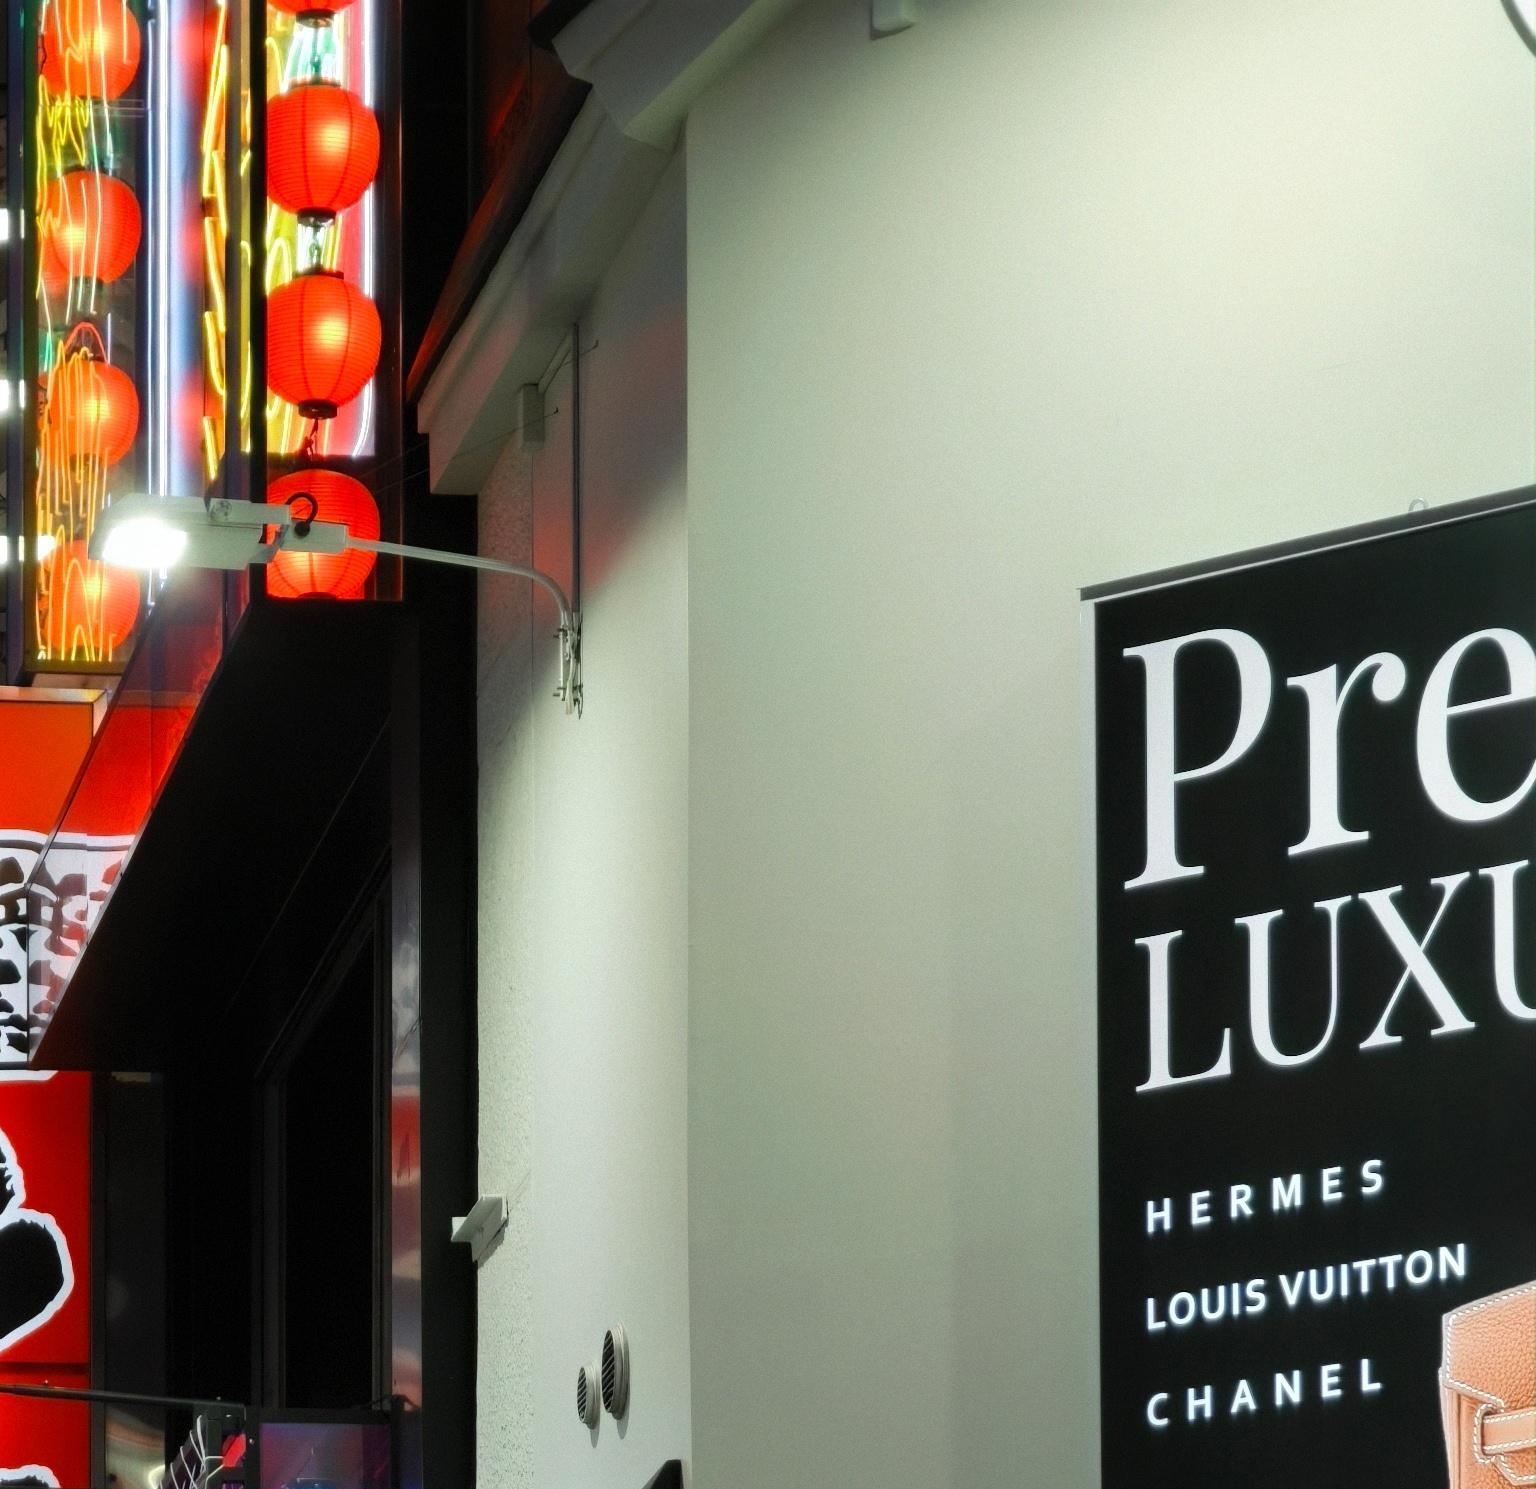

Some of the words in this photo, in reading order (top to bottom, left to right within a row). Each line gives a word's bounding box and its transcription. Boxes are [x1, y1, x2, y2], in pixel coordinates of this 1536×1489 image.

[1123, 628, 1536, 890] Pre
[1147, 1159, 1383, 1234] HERMES
[1148, 1278, 1267, 1331] LOUIS
[1279, 1243, 1466, 1306] VUITTON
[1148, 1358, 1382, 1426] CHANEL
